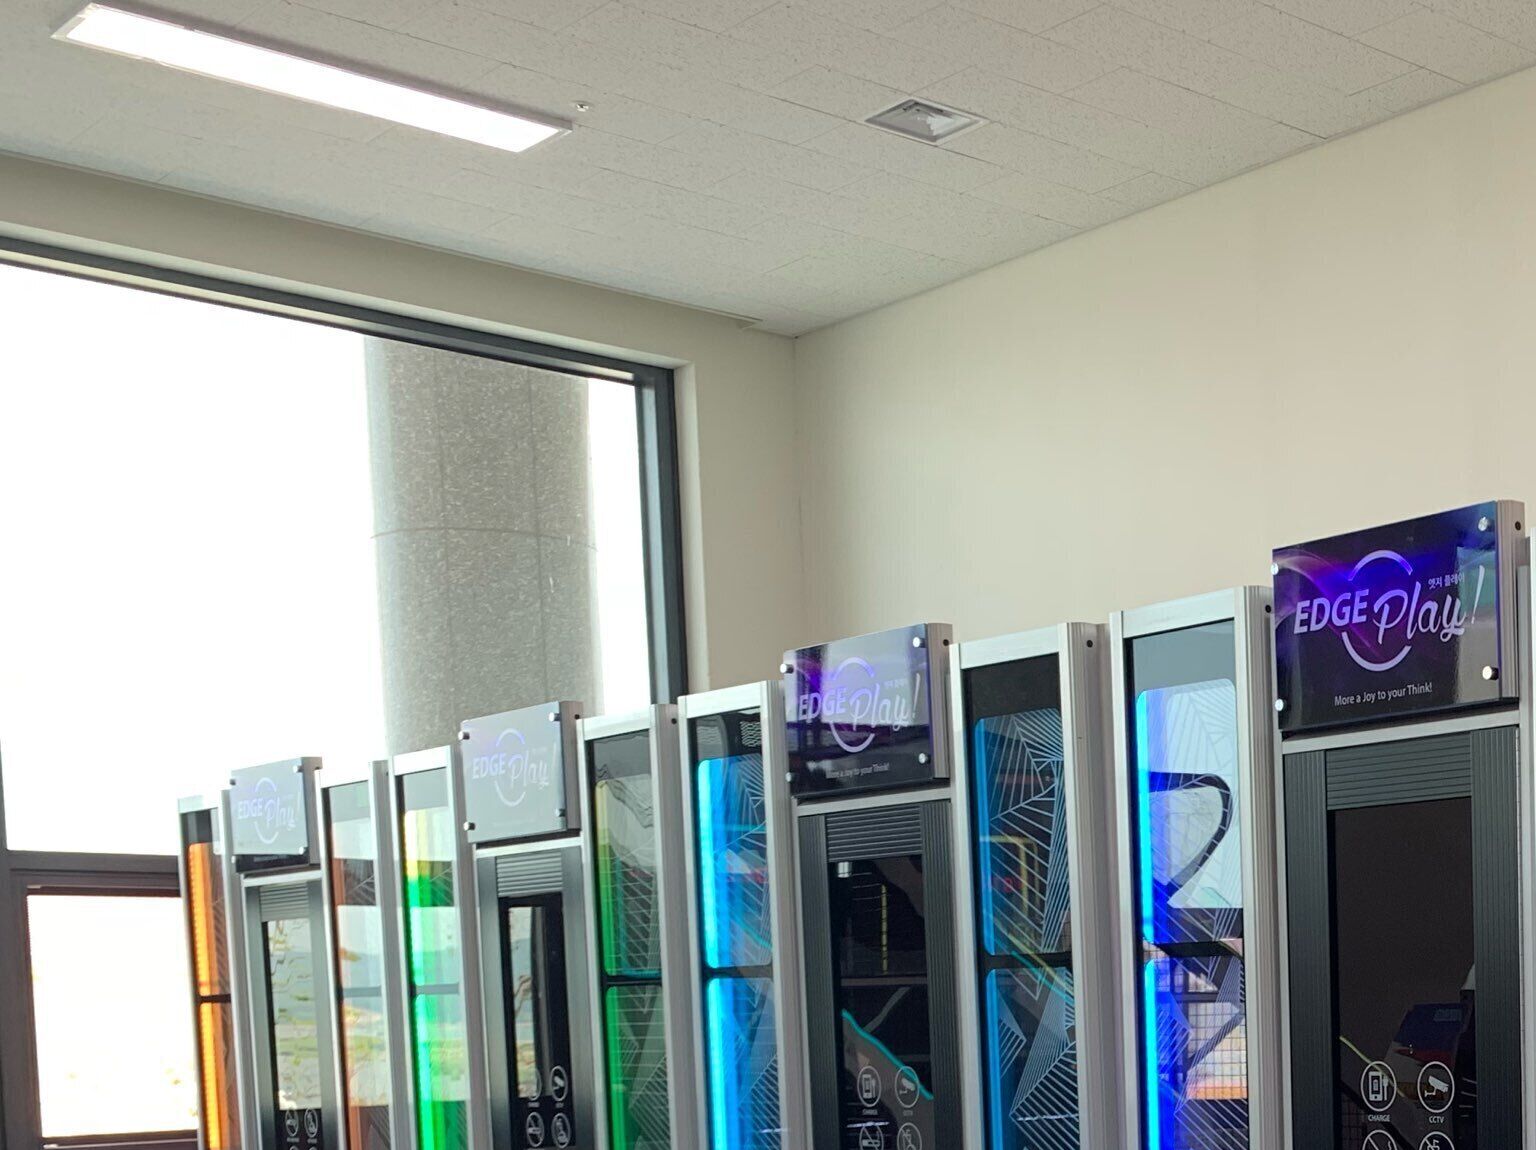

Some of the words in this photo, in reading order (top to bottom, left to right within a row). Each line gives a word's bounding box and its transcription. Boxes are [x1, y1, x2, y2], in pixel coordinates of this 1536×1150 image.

[1293, 589, 1369, 635] EDGE
[1373, 565, 1485, 644] Play!
[799, 686, 847, 721] EDGE
[850, 672, 921, 731] Play!
[1334, 695, 1354, 706] More
[1355, 695, 1361, 703] a
[1363, 692, 1376, 703] Joy
[1377, 691, 1386, 700] to
[1388, 688, 1406, 701] your
[1406, 682, 1432, 695] Think!
[472, 753, 506, 779] EDGE
[237, 798, 263, 820] EDGE
[1368, 1114, 1390, 1122] CHARGE
